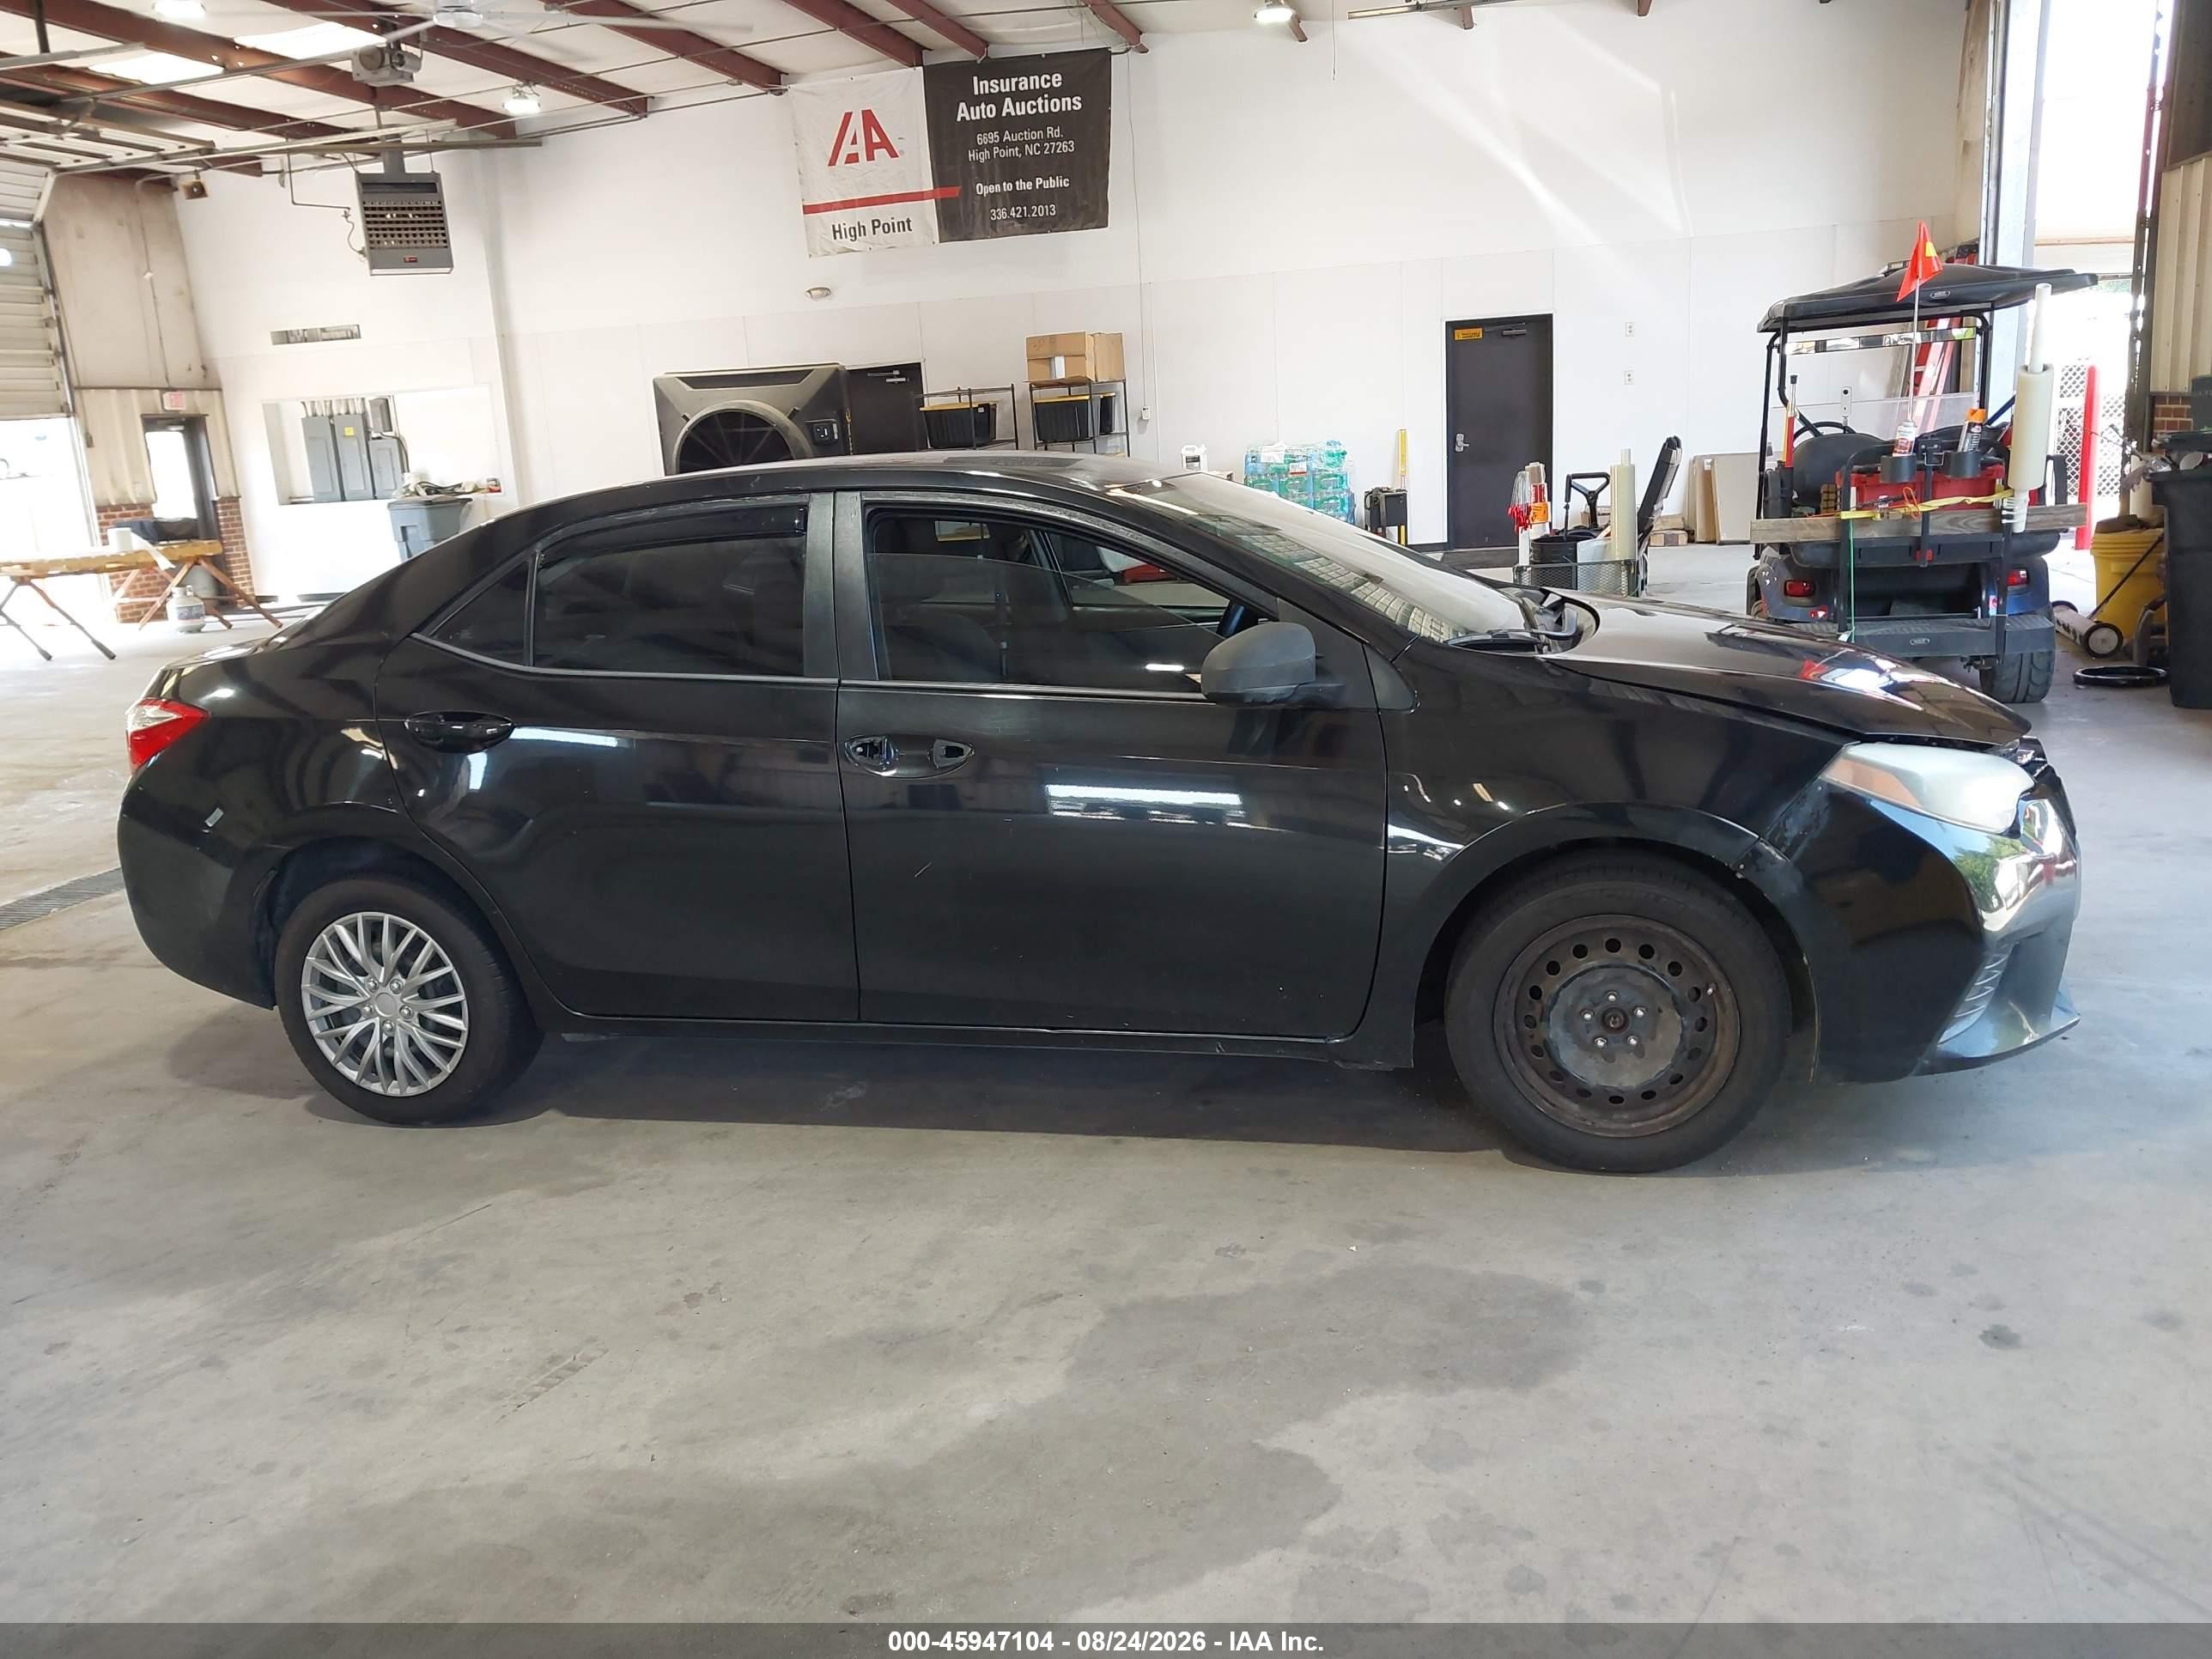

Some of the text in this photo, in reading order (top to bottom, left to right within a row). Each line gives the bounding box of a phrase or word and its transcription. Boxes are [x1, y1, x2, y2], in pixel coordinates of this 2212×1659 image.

[973, 72, 1062, 95] Insurance
[957, 94, 1082, 122] Auto Auctions
[976, 126, 1064, 145] 6695 Auction Rd.
[969, 140, 1075, 163] High Point, NC 27263
[975, 175, 1070, 198] Open to the Public
[990, 204, 1056, 221] 336.421.2013
[831, 216, 913, 241] High Point
